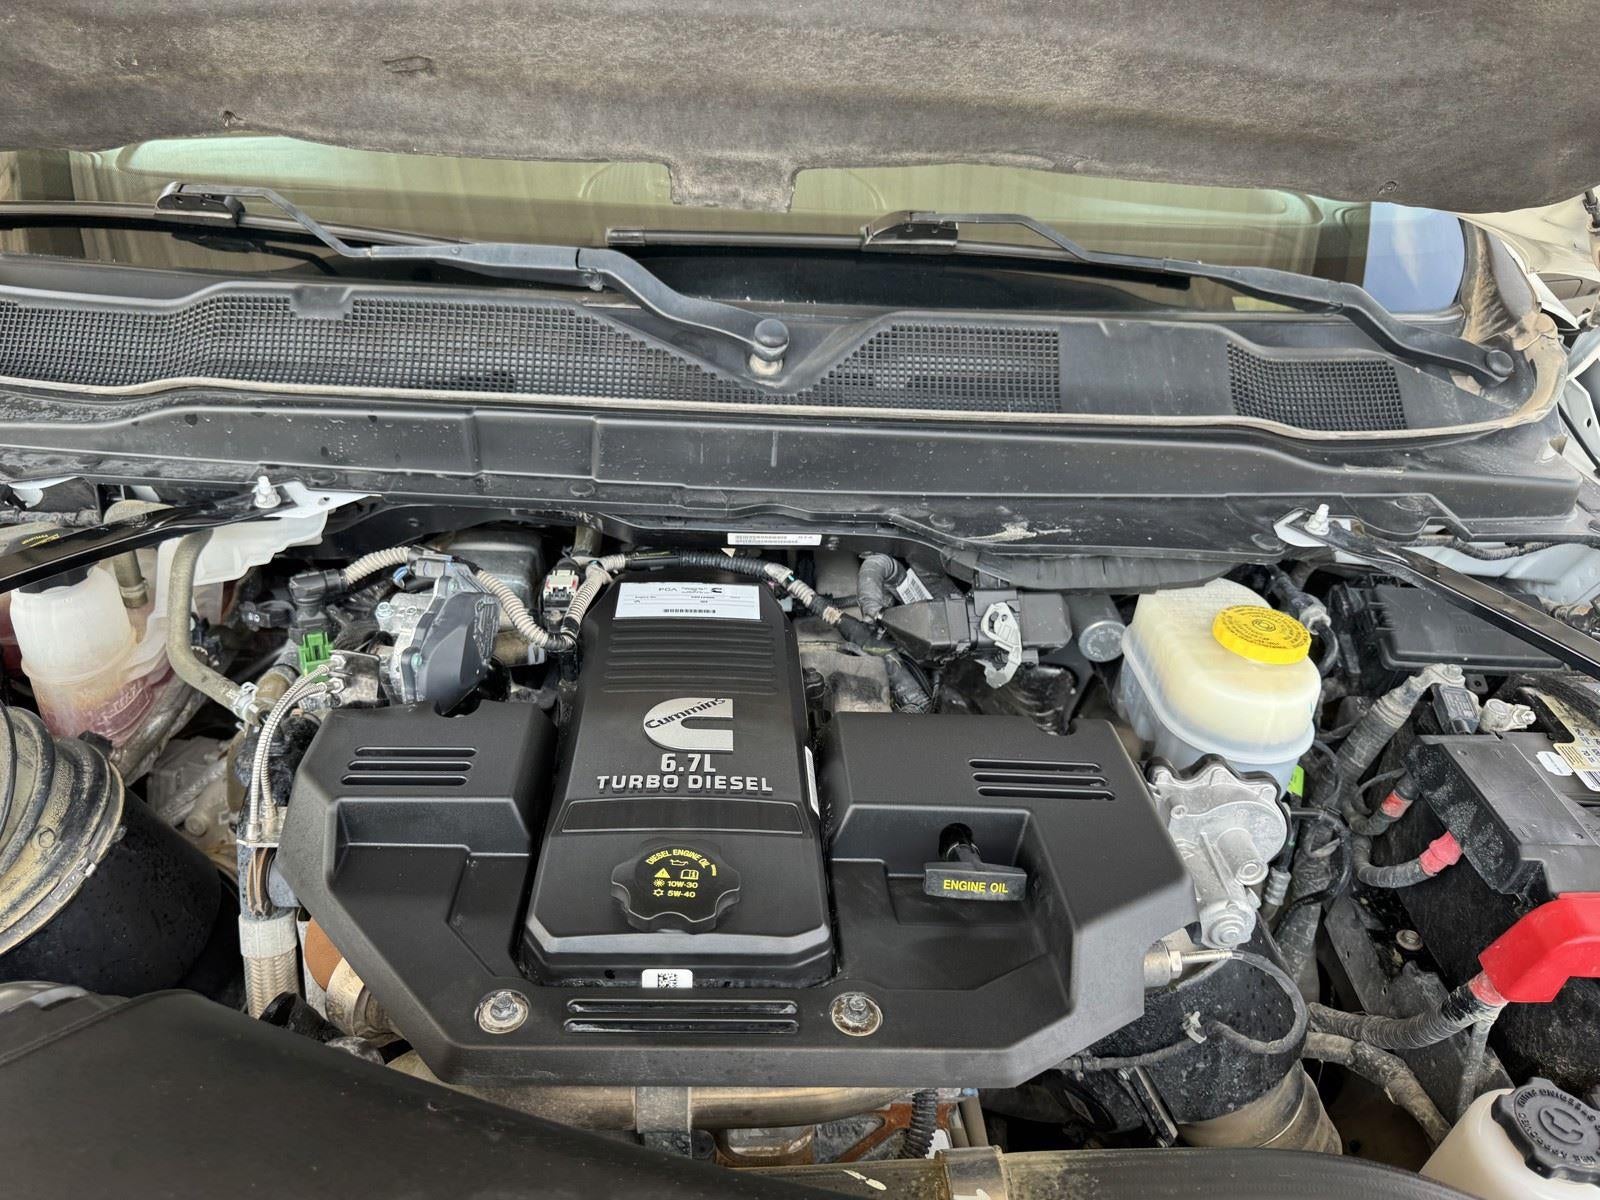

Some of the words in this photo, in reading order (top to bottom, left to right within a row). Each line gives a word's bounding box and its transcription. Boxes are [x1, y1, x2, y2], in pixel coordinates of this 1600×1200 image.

[645, 697, 726, 729] Cummins
[660, 753, 716, 773] 6.7L
[596, 774, 679, 790] TURBO
[687, 775, 773, 792] DIESEL
[645, 850, 671, 864] DIESEL
[672, 849, 702, 861] ENGINE
[667, 880, 698, 889] 10W-30
[943, 879, 986, 892] ENGINE
[989, 882, 1009, 893] OIL
